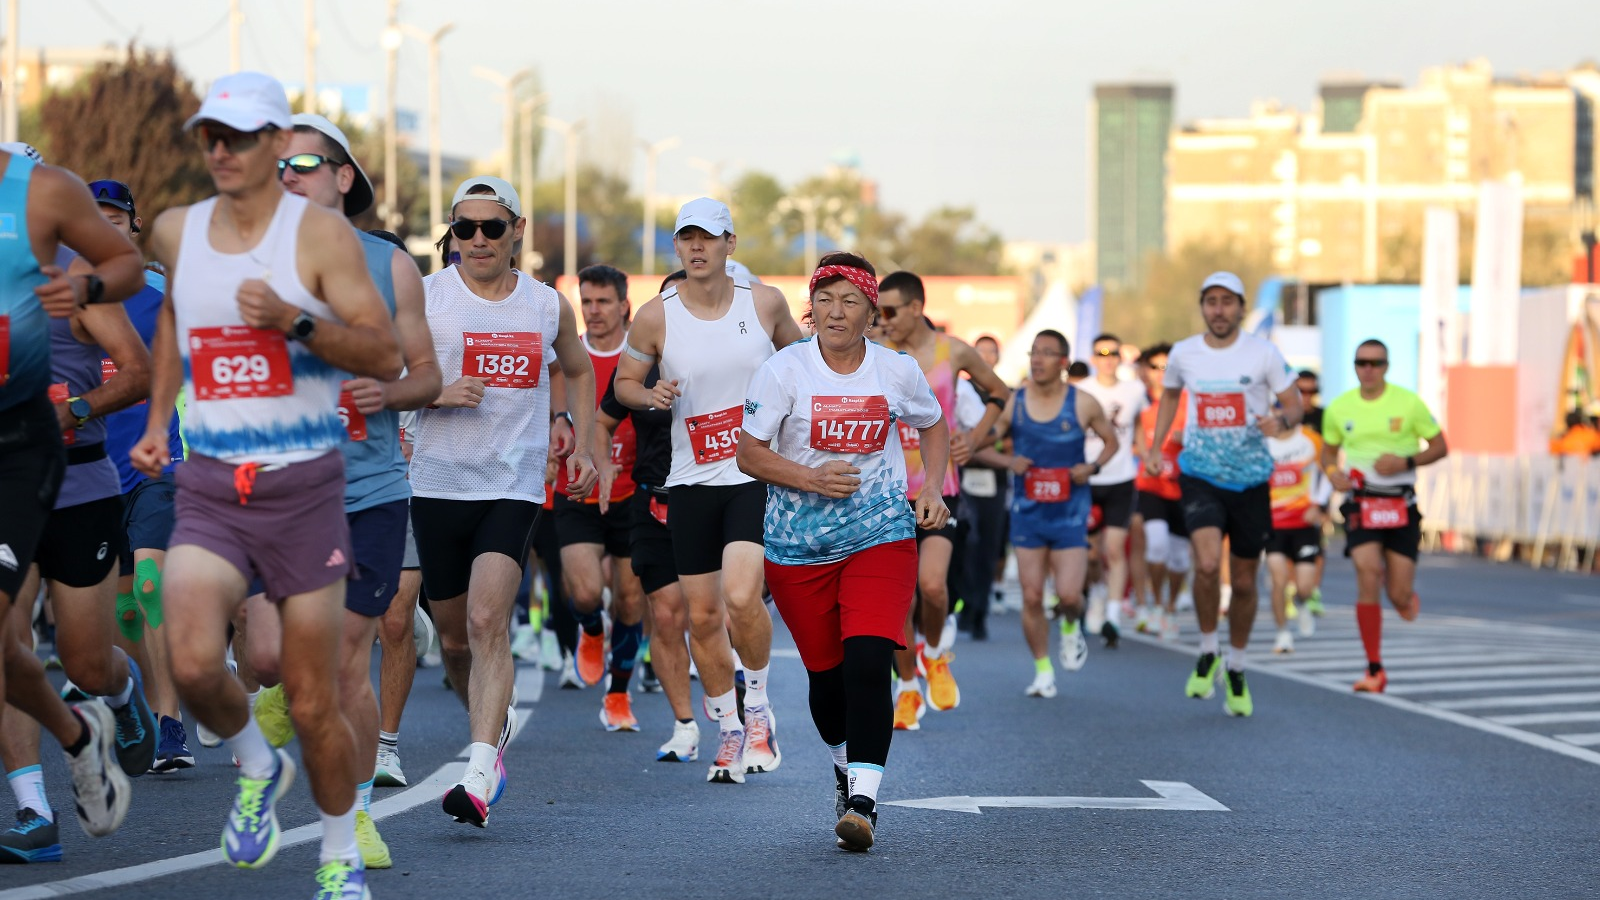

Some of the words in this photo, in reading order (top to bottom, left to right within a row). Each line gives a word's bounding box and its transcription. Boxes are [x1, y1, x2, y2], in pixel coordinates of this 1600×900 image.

[466, 337, 474, 346] B
[212, 354, 270, 385] 629
[475, 354, 530, 376] 1382
[336, 406, 350, 428] 6
[814, 402, 822, 412] C
[705, 426, 742, 450] 430
[817, 419, 885, 441] 14777
[611, 443, 624, 458] 7
